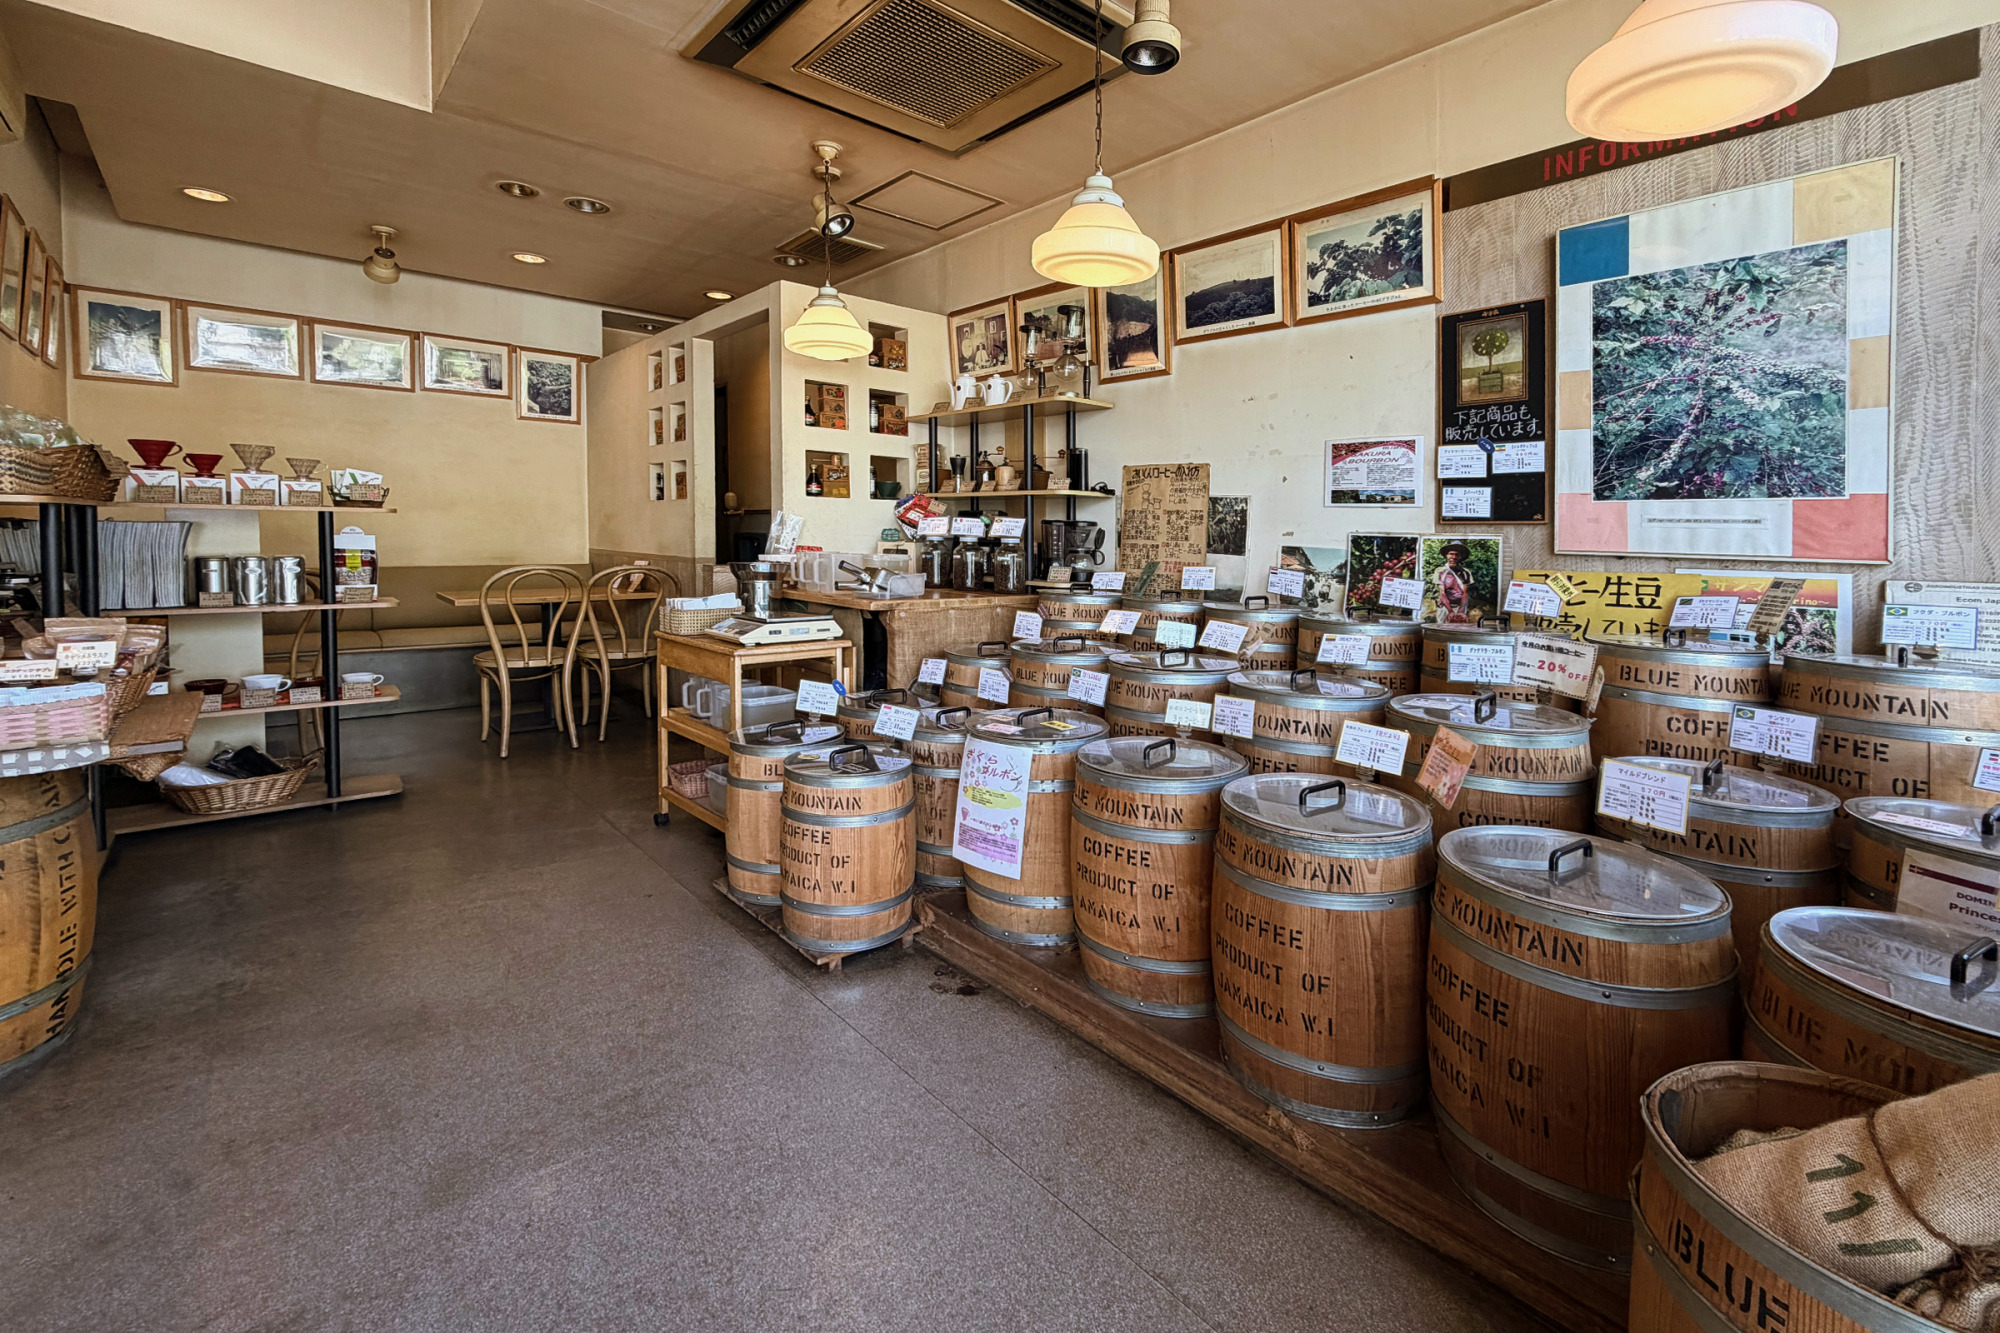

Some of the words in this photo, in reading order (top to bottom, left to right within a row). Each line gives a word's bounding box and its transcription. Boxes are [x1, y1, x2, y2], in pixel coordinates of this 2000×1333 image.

[1453, 404, 1531, 425] 下記商品も
[1445, 418, 1543, 442] 販売しています。
[1528, 573, 1663, 610] ヒー生豆
[1016, 667, 1037, 682] BLUE
[1042, 670, 1071, 685] MOUN
[1537, 660, 1567, 674] 20%
[1568, 671, 1588, 682] OFF
[1619, 665, 1680, 689] BLUE
[1811, 685, 1949, 720] MOUNTAIN
[1254, 714, 1332, 738] OUNTAIN
[1666, 716, 1729, 738] COFF
[1768, 714, 1796, 724] サンマリノ
[966, 748, 998, 765] さくら
[1489, 755, 1582, 775] MOUNTAIN
[764, 763, 784, 777] BL
[1618, 767, 1667, 784] マイルドブレンド
[1787, 762, 1868, 790] RODUCT
[1892, 777, 1931, 799] OF
[791, 789, 862, 811] MOUNTAIN
[1641, 787, 1666, 798] 570円
[1095, 795, 1183, 824] MOUNTAIN
[782, 821, 831, 846] COFFEE
[830, 855, 851, 869] OF
[1083, 836, 1151, 868] COFFEE
[1242, 843, 1353, 886] MOUNTAIN
[1077, 861, 1137, 897] PRODUCT
[1152, 883, 1175, 900] OF
[1956, 892, 1996, 907] DOMIN
[1949, 902, 2000, 923] Prince
[1225, 902, 1303, 950] COFFEE
[1452, 895, 1583, 966] MOUNTAIN
[1216, 931, 1283, 985] PRODUCT
[1302, 972, 1331, 995] OF
[1218, 972, 1289, 1026] JAMAICA
[1431, 954, 1511, 1028] COFFEE
[1761, 985, 1826, 1050] BLUE
[1428, 1000, 1488, 1062] RODUCT
[1507, 1057, 1543, 1089] OF
[1674, 1218, 1790, 1333] BLUE
